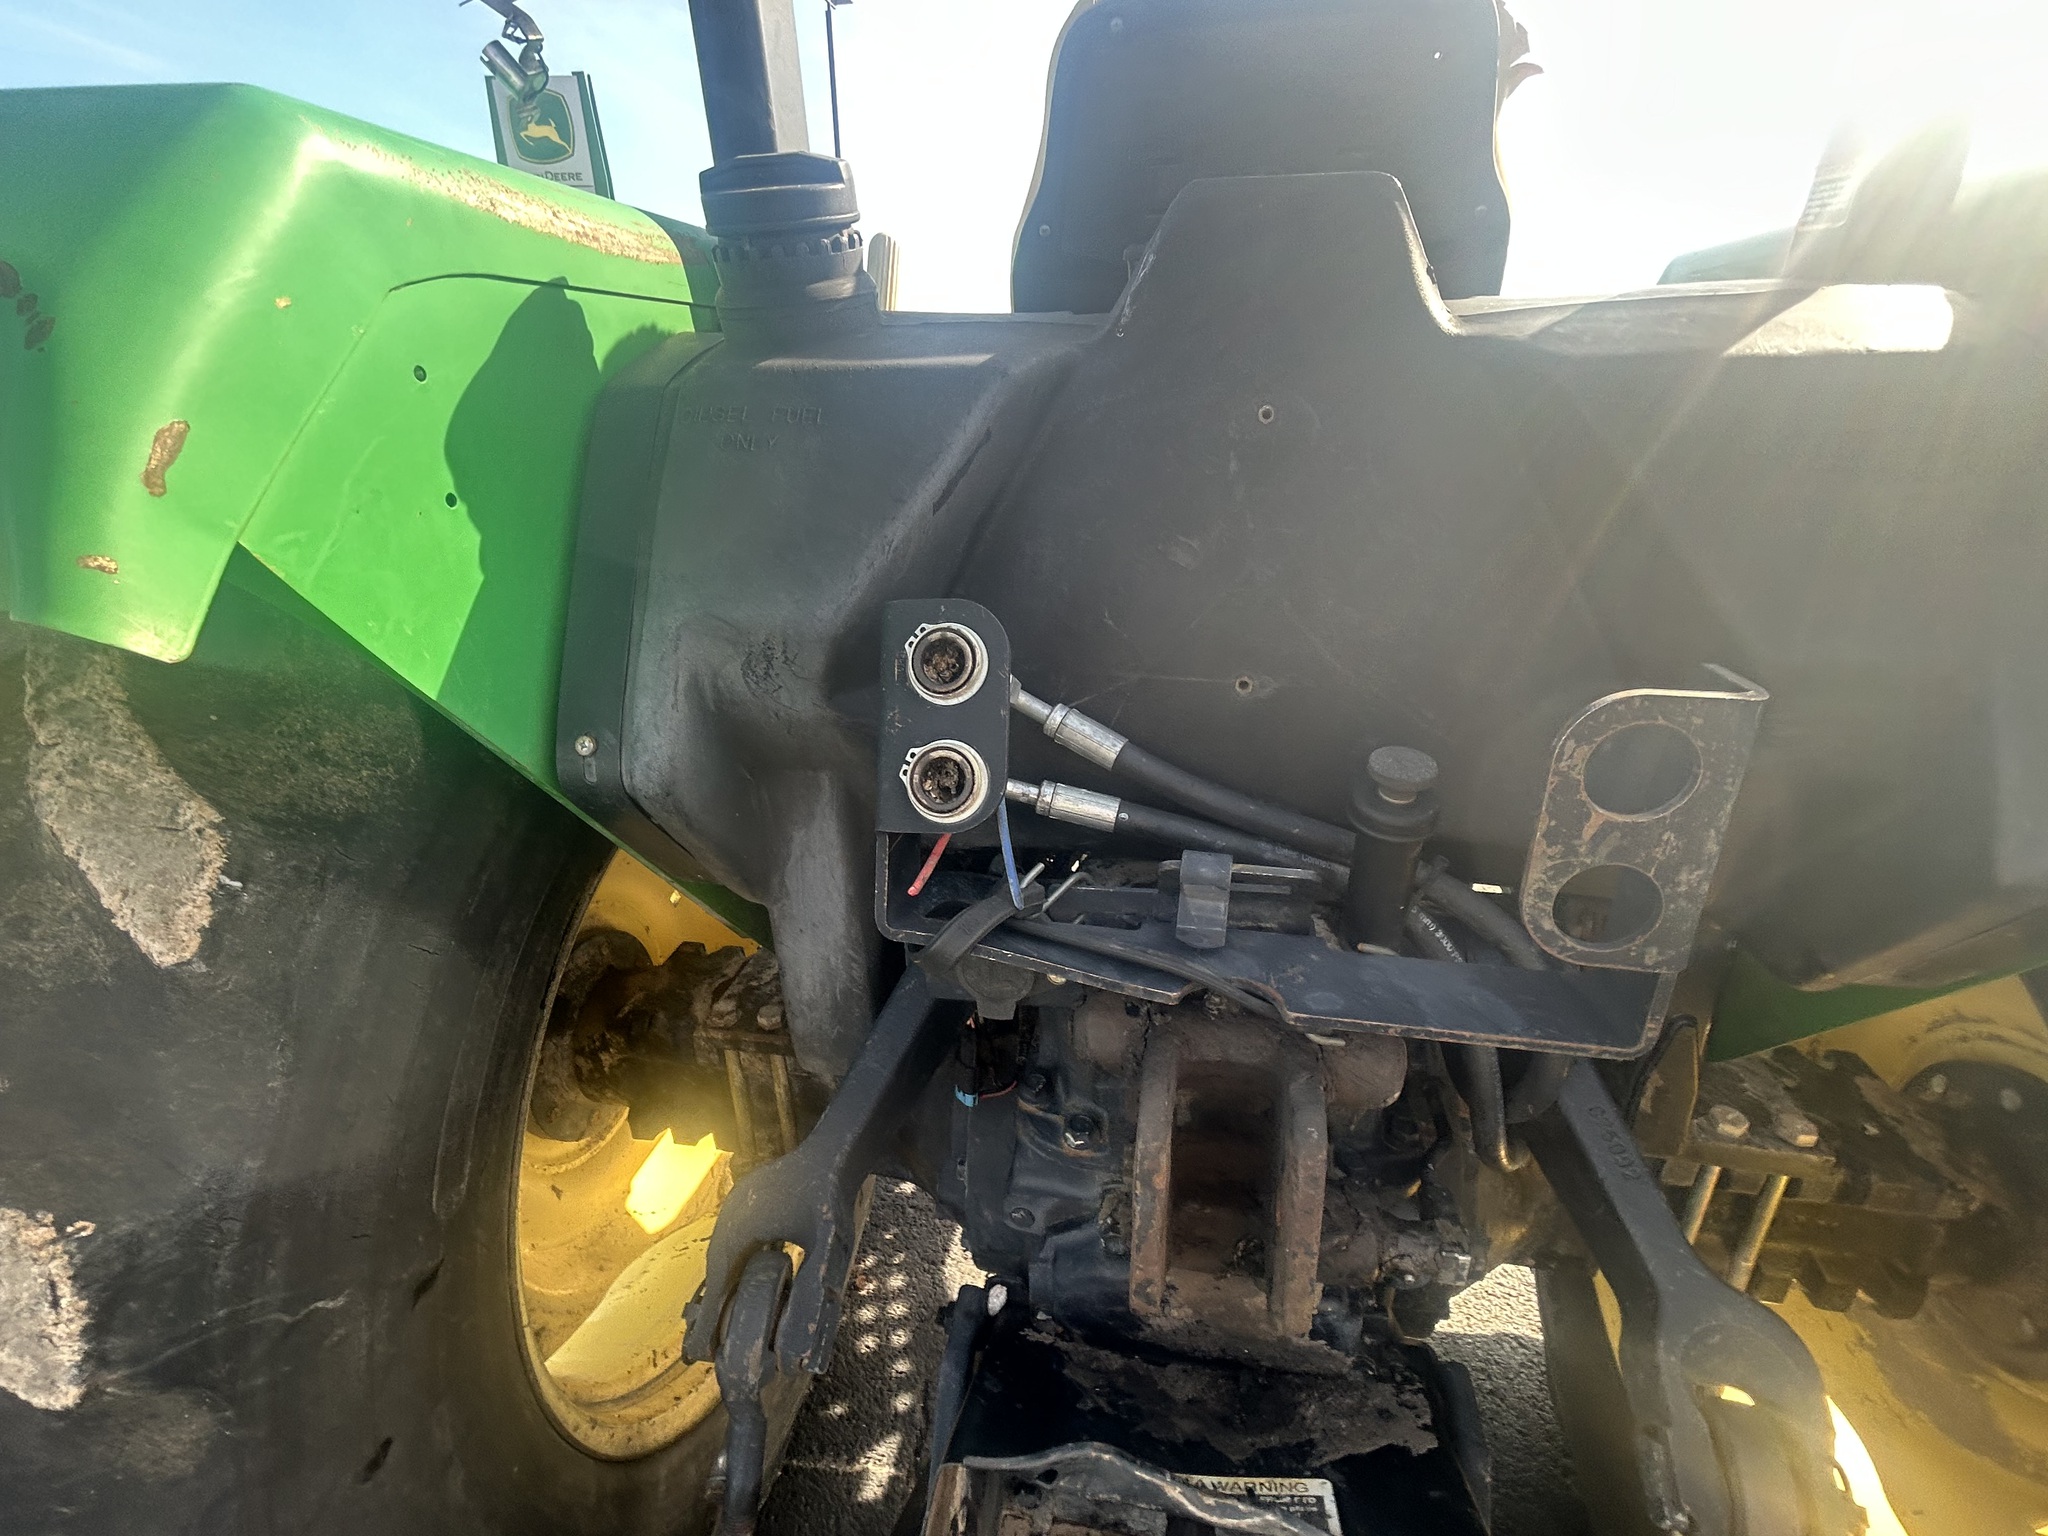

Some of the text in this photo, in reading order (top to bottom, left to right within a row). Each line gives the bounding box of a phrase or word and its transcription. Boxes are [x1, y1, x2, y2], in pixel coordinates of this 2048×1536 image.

[545, 171, 583, 181] DEERE
[771, 405, 827, 425] FUEL
[720, 432, 779, 451] ONLY
[1211, 1479, 1309, 1493] WARNING
